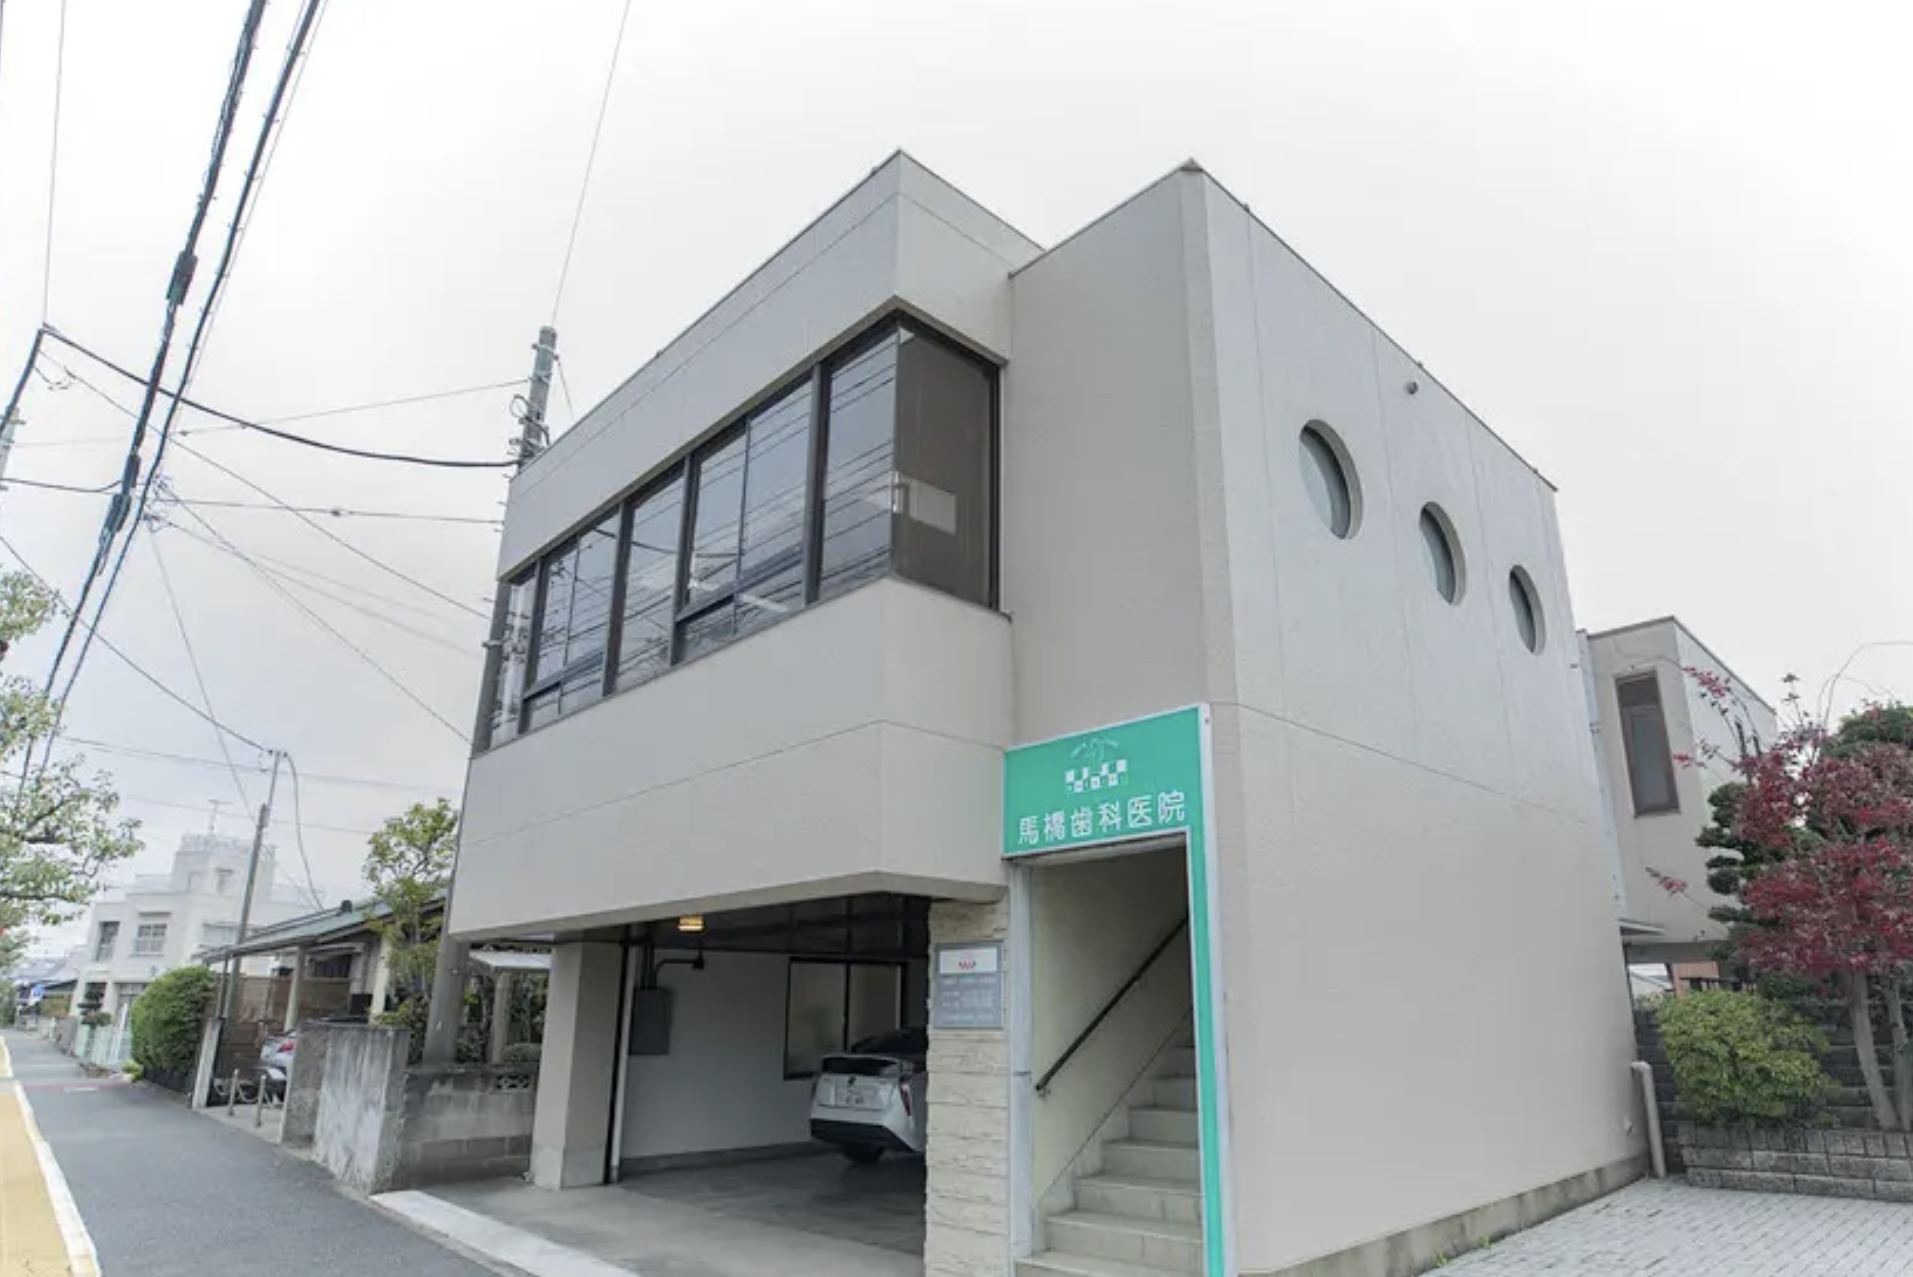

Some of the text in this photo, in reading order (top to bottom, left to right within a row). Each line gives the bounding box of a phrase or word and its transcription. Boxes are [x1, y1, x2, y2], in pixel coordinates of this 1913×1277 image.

[1018, 789, 1186, 845] 馬橋歯科医院
